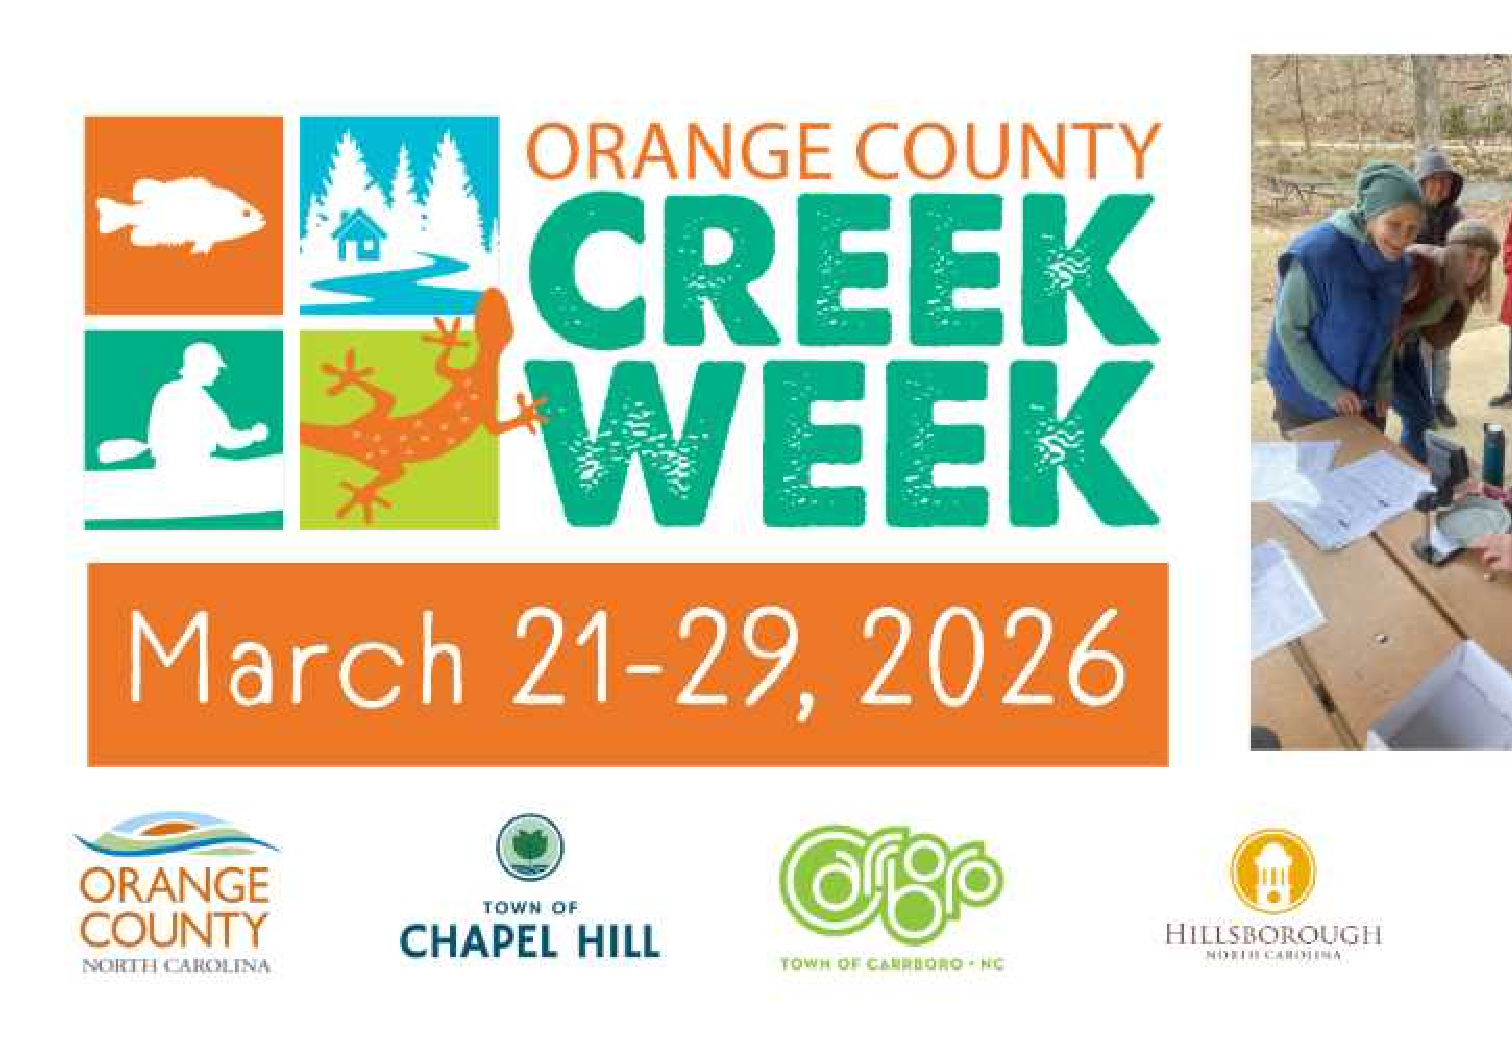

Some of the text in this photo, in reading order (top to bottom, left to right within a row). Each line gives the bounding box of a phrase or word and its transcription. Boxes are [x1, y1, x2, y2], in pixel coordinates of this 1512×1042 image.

[527, 123, 1161, 181] ORANGE COUNTY
[528, 191, 1162, 350] CREEK
[524, 360, 1162, 528] WEEK
[131, 606, 1126, 722] March 21-29, 2026
[81, 867, 269, 904] ORANGE
[483, 900, 579, 914] TOWN OF
[80, 911, 270, 949] COUNTY
[399, 924, 661, 960] CHAPEL HILL
[1166, 923, 1381, 945] HILLSBOROUGH
[82, 958, 272, 973] NORTH CAROLINA
[780, 957, 1004, 971] TOWN OF CARRBORO NC
